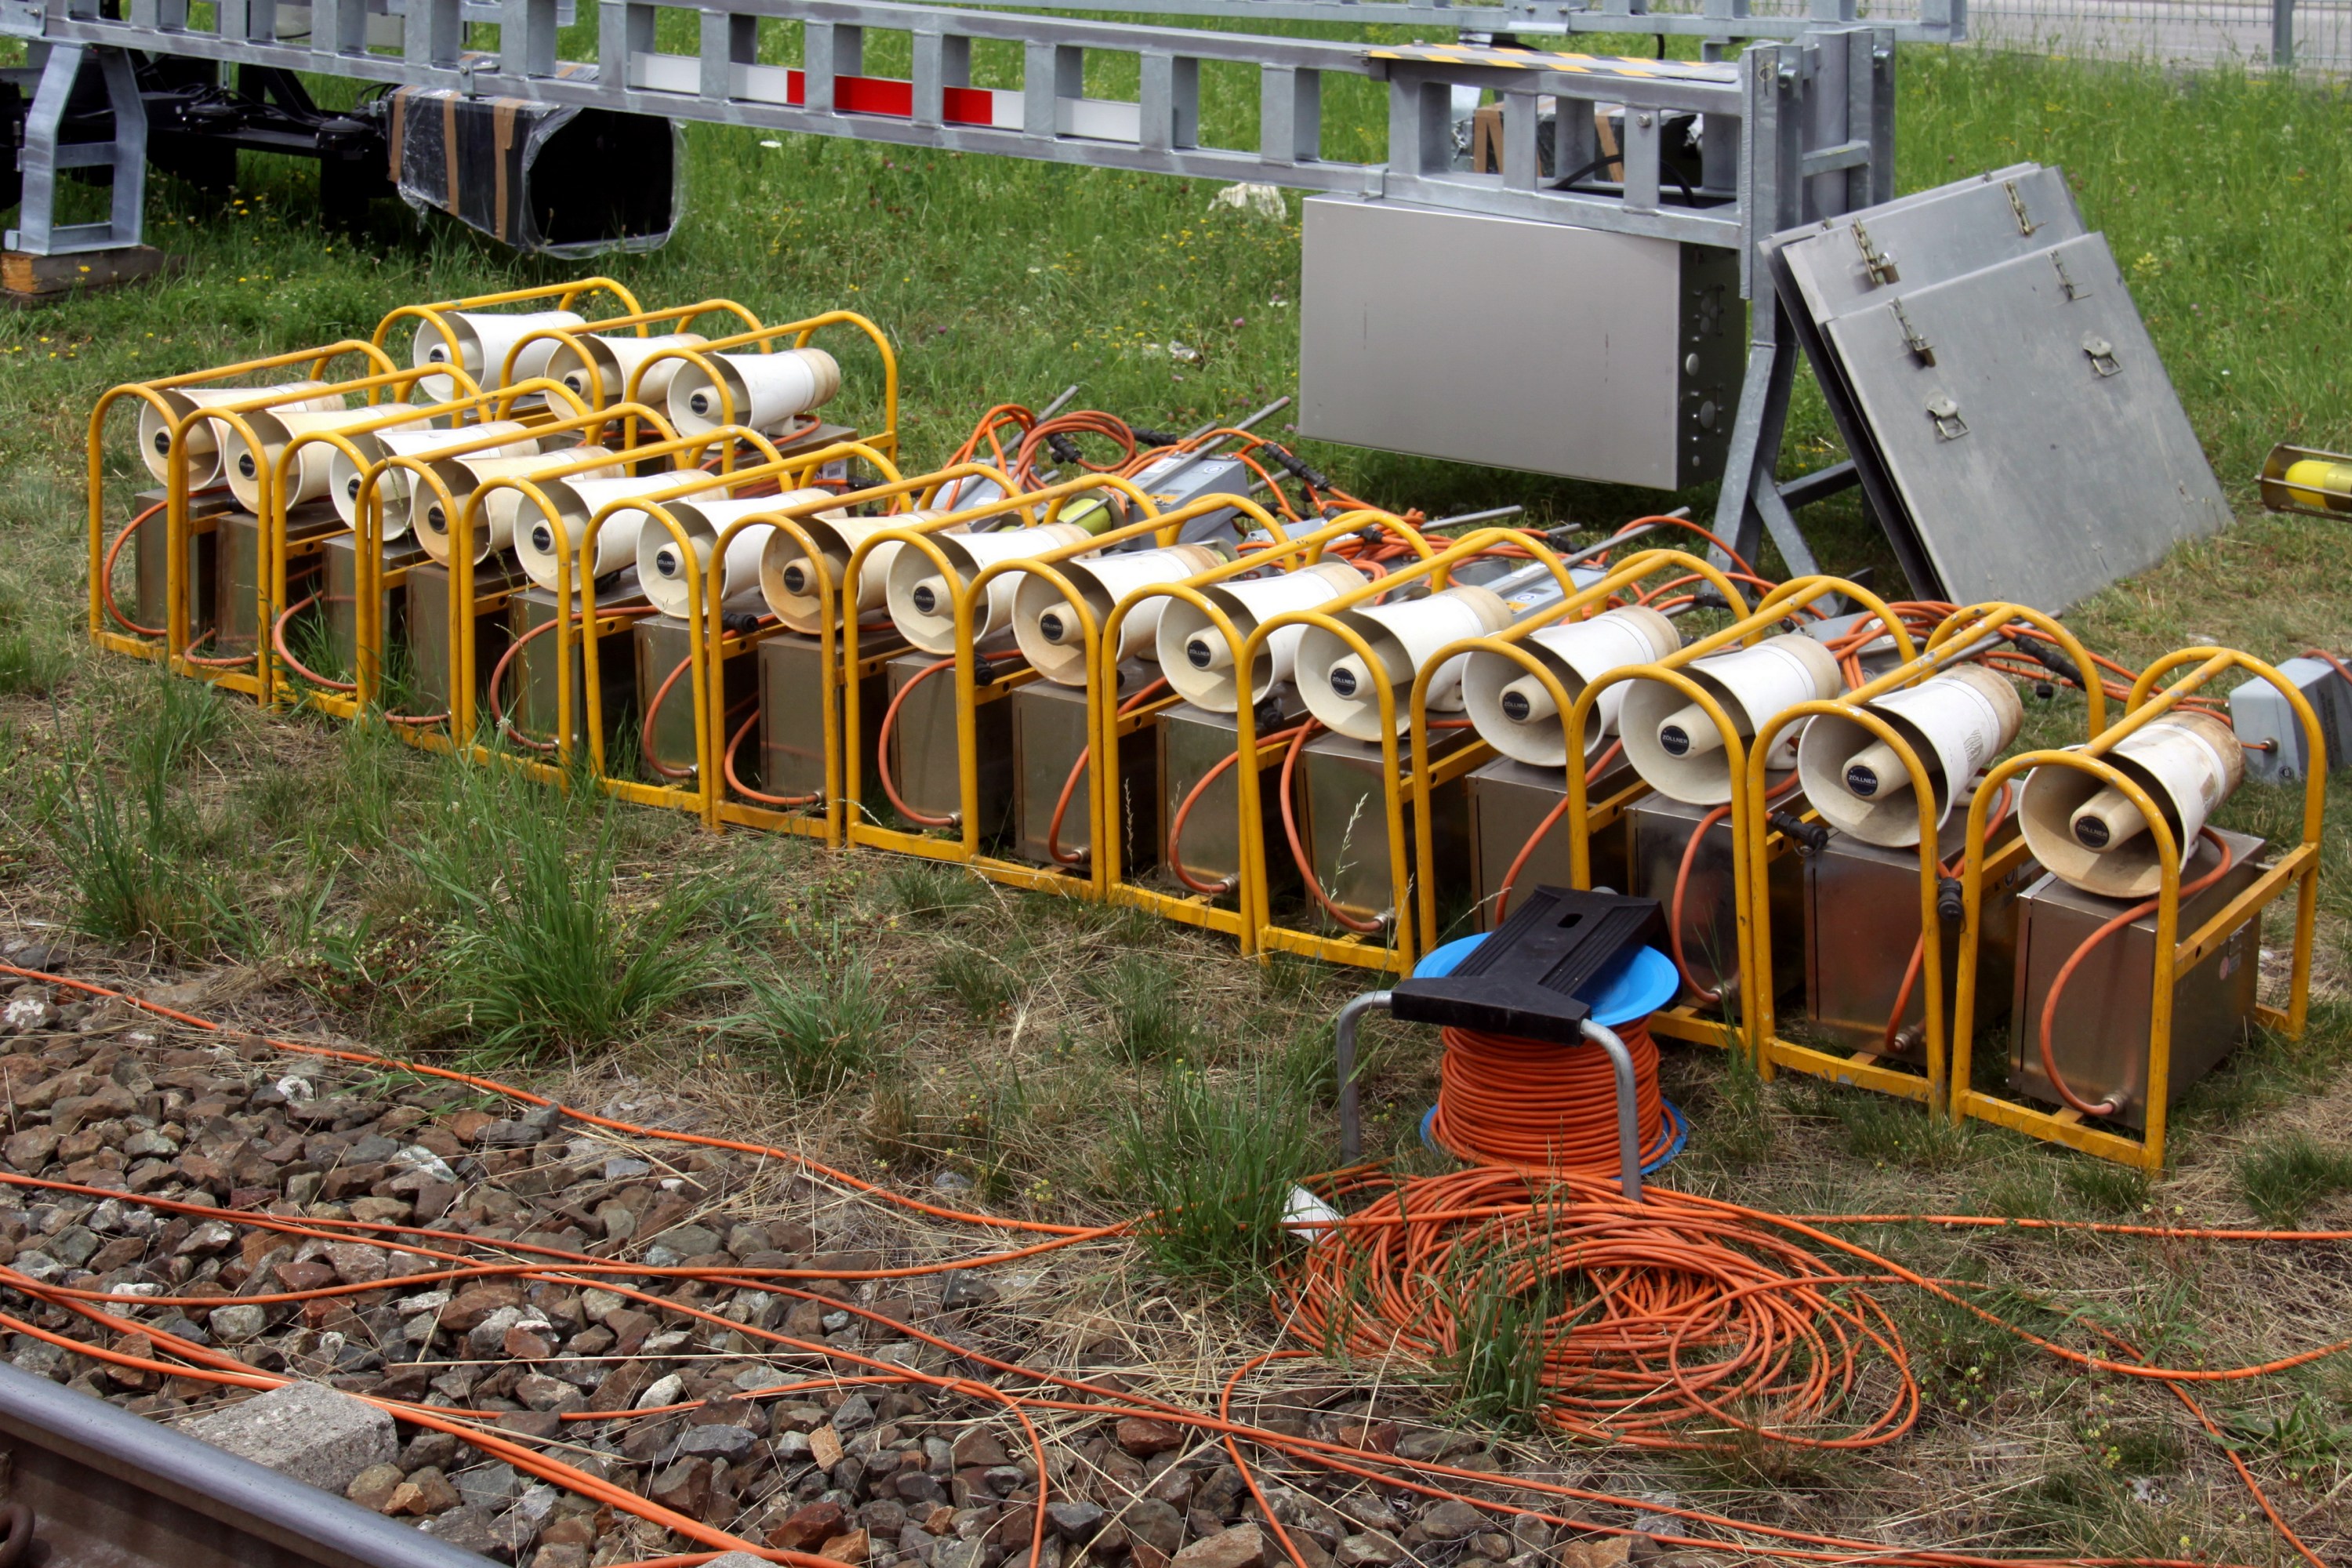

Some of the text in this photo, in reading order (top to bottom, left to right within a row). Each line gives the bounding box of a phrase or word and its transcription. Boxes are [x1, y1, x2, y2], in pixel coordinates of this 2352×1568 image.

[1189, 648, 1210, 657] ZÖLLNER
[1332, 676, 1356, 685] ZÖLLNER
[1662, 735, 1688, 744] ZÖLLNER
[1848, 775, 1877, 785] ZÖLLNER
[2078, 824, 2109, 838] ZÖLLNER
